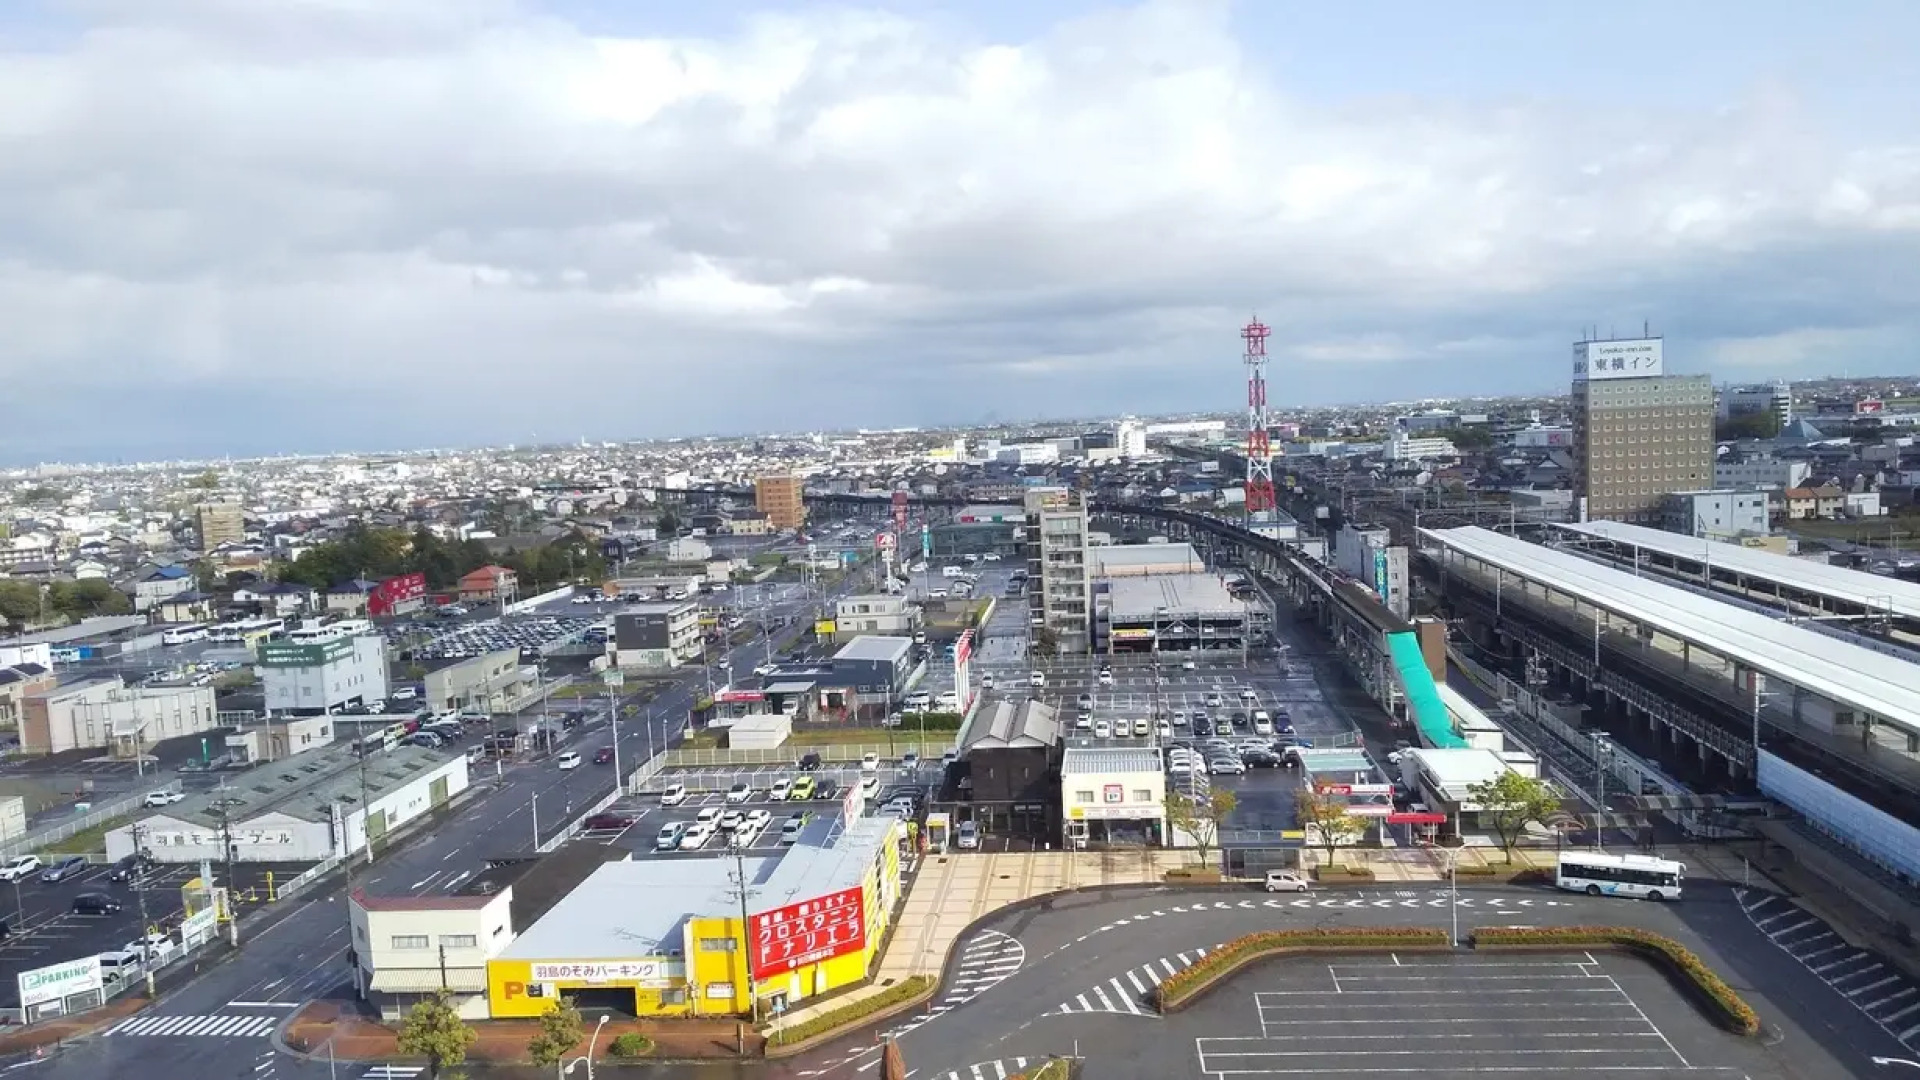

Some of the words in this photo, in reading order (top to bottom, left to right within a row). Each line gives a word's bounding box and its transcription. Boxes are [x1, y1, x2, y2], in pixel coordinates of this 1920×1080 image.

[1594, 356, 1657, 372] 東横イン
[759, 905, 859, 943] クロスタニン
[761, 919, 859, 964] ドナリエラ
[41, 965, 89, 985] PARKING
[504, 981, 524, 1000] P
